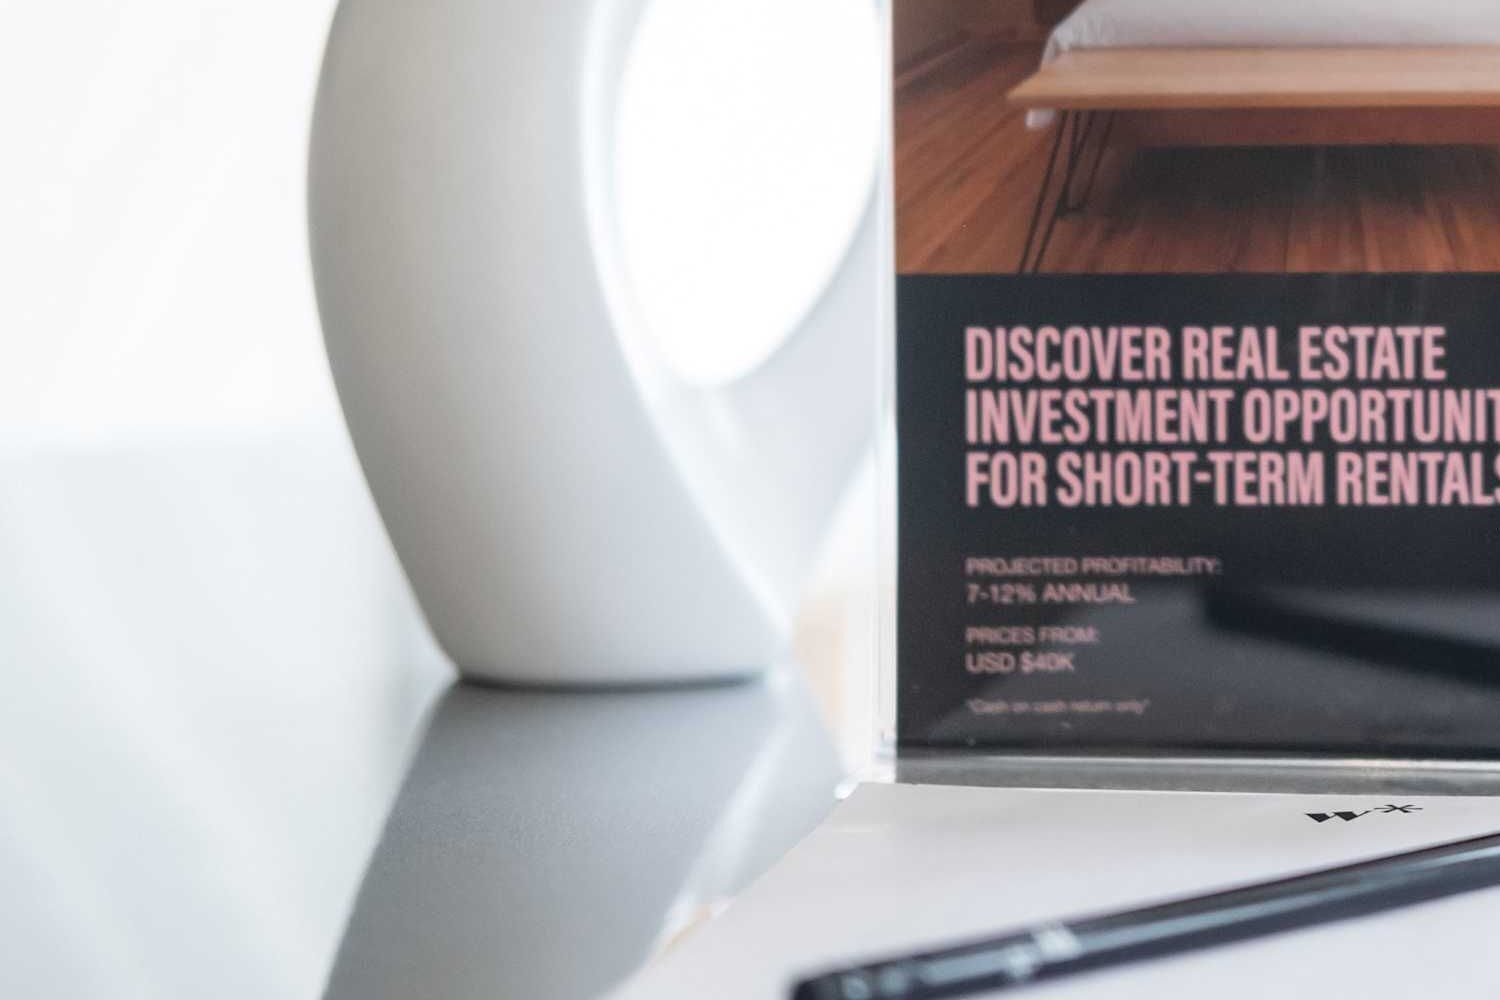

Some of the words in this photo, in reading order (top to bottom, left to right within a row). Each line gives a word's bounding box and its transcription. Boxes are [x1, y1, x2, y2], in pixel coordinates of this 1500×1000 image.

[965, 326, 1171, 380] DISCOVER
[1183, 326, 1290, 380] REAL
[1300, 326, 1447, 380] ESTATE
[966, 389, 1234, 443] INVESTMENT
[966, 452, 1047, 505] FOR
[1056, 451, 1324, 505] SHORT-TERM
[966, 557, 1078, 575] PROJECTED
[1082, 556, 1222, 575] PROFITABILITY:
[966, 583, 1036, 603] 7-12%
[1042, 582, 1136, 603] ANNUAL
[966, 626, 1036, 644] PRICES
[966, 653, 1016, 673] USD
[1020, 652, 1075, 673] $40K
